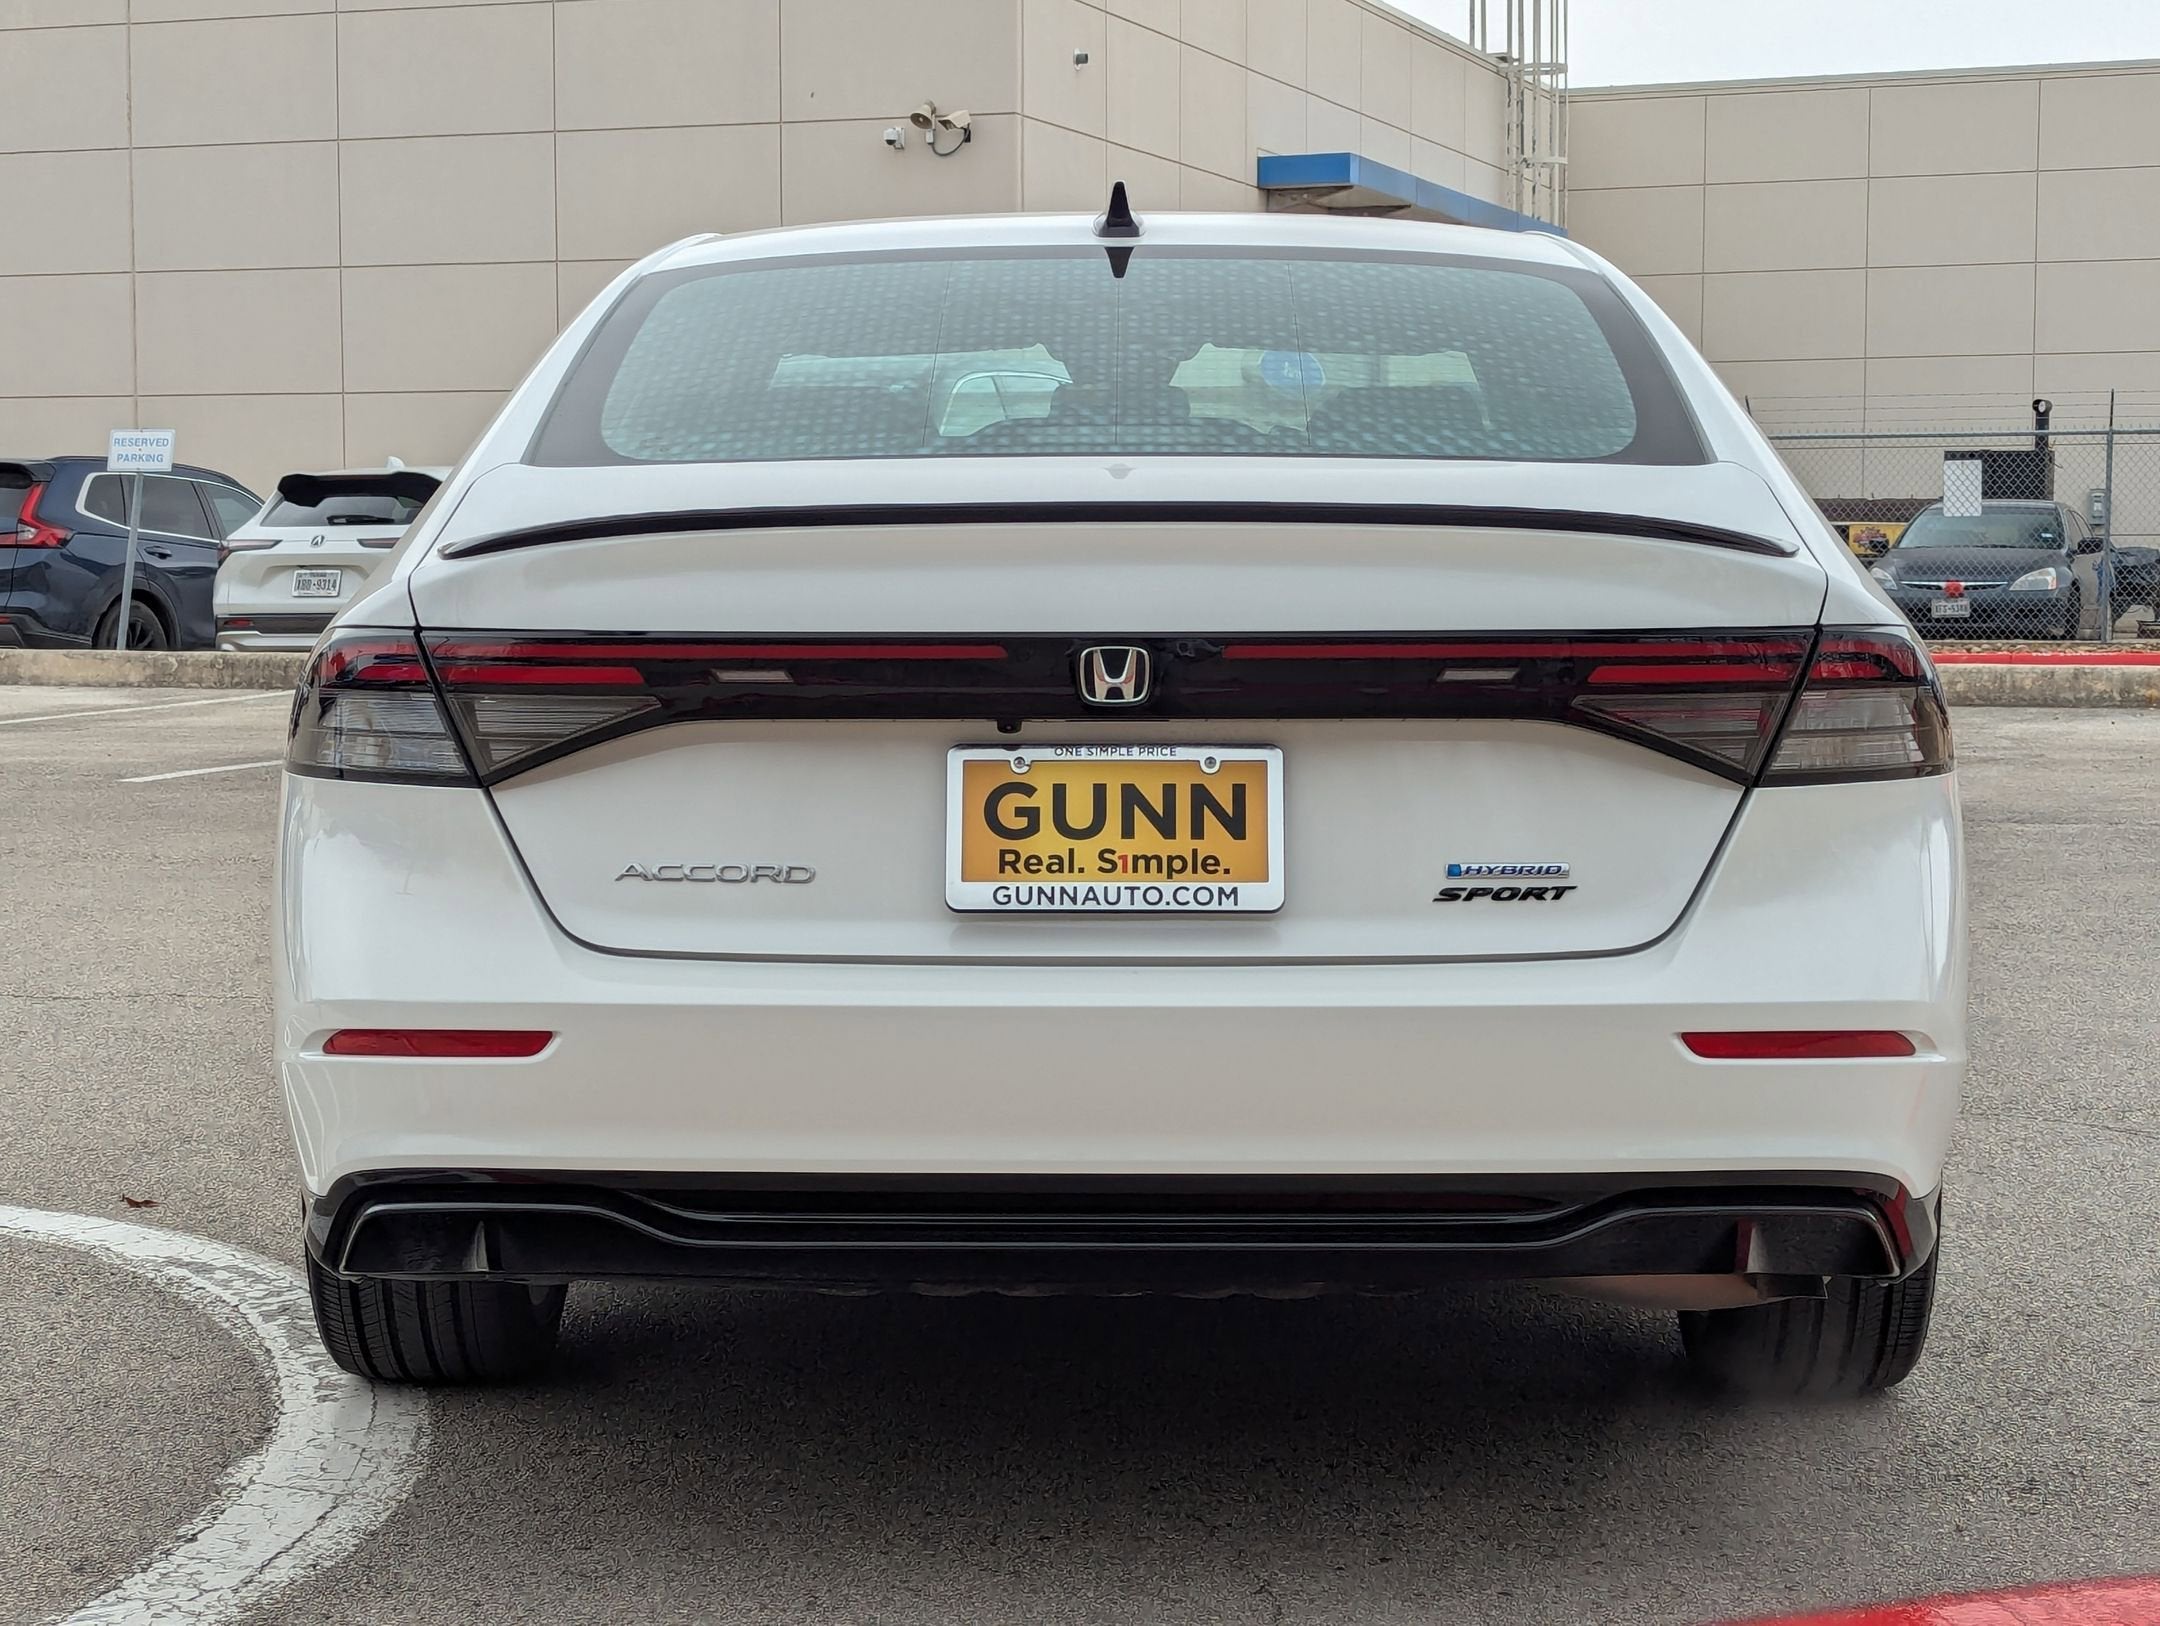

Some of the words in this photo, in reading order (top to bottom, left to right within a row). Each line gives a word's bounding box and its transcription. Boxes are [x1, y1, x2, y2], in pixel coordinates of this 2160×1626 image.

[113, 437, 169, 447] RESERVED
[116, 453, 164, 463] PARKING
[1054, 745, 1083, 757] ONE
[1087, 745, 1134, 757] SIMPLE
[1138, 745, 1177, 757] PRICE
[984, 781, 1247, 841] GUNN
[998, 848, 1085, 874] Real.
[614, 863, 817, 884] ACCORD
[1464, 864, 1564, 876] HYBRID
[992, 885, 1239, 906] GUNNAUTO.COM
[1432, 885, 1578, 902] SPORT
